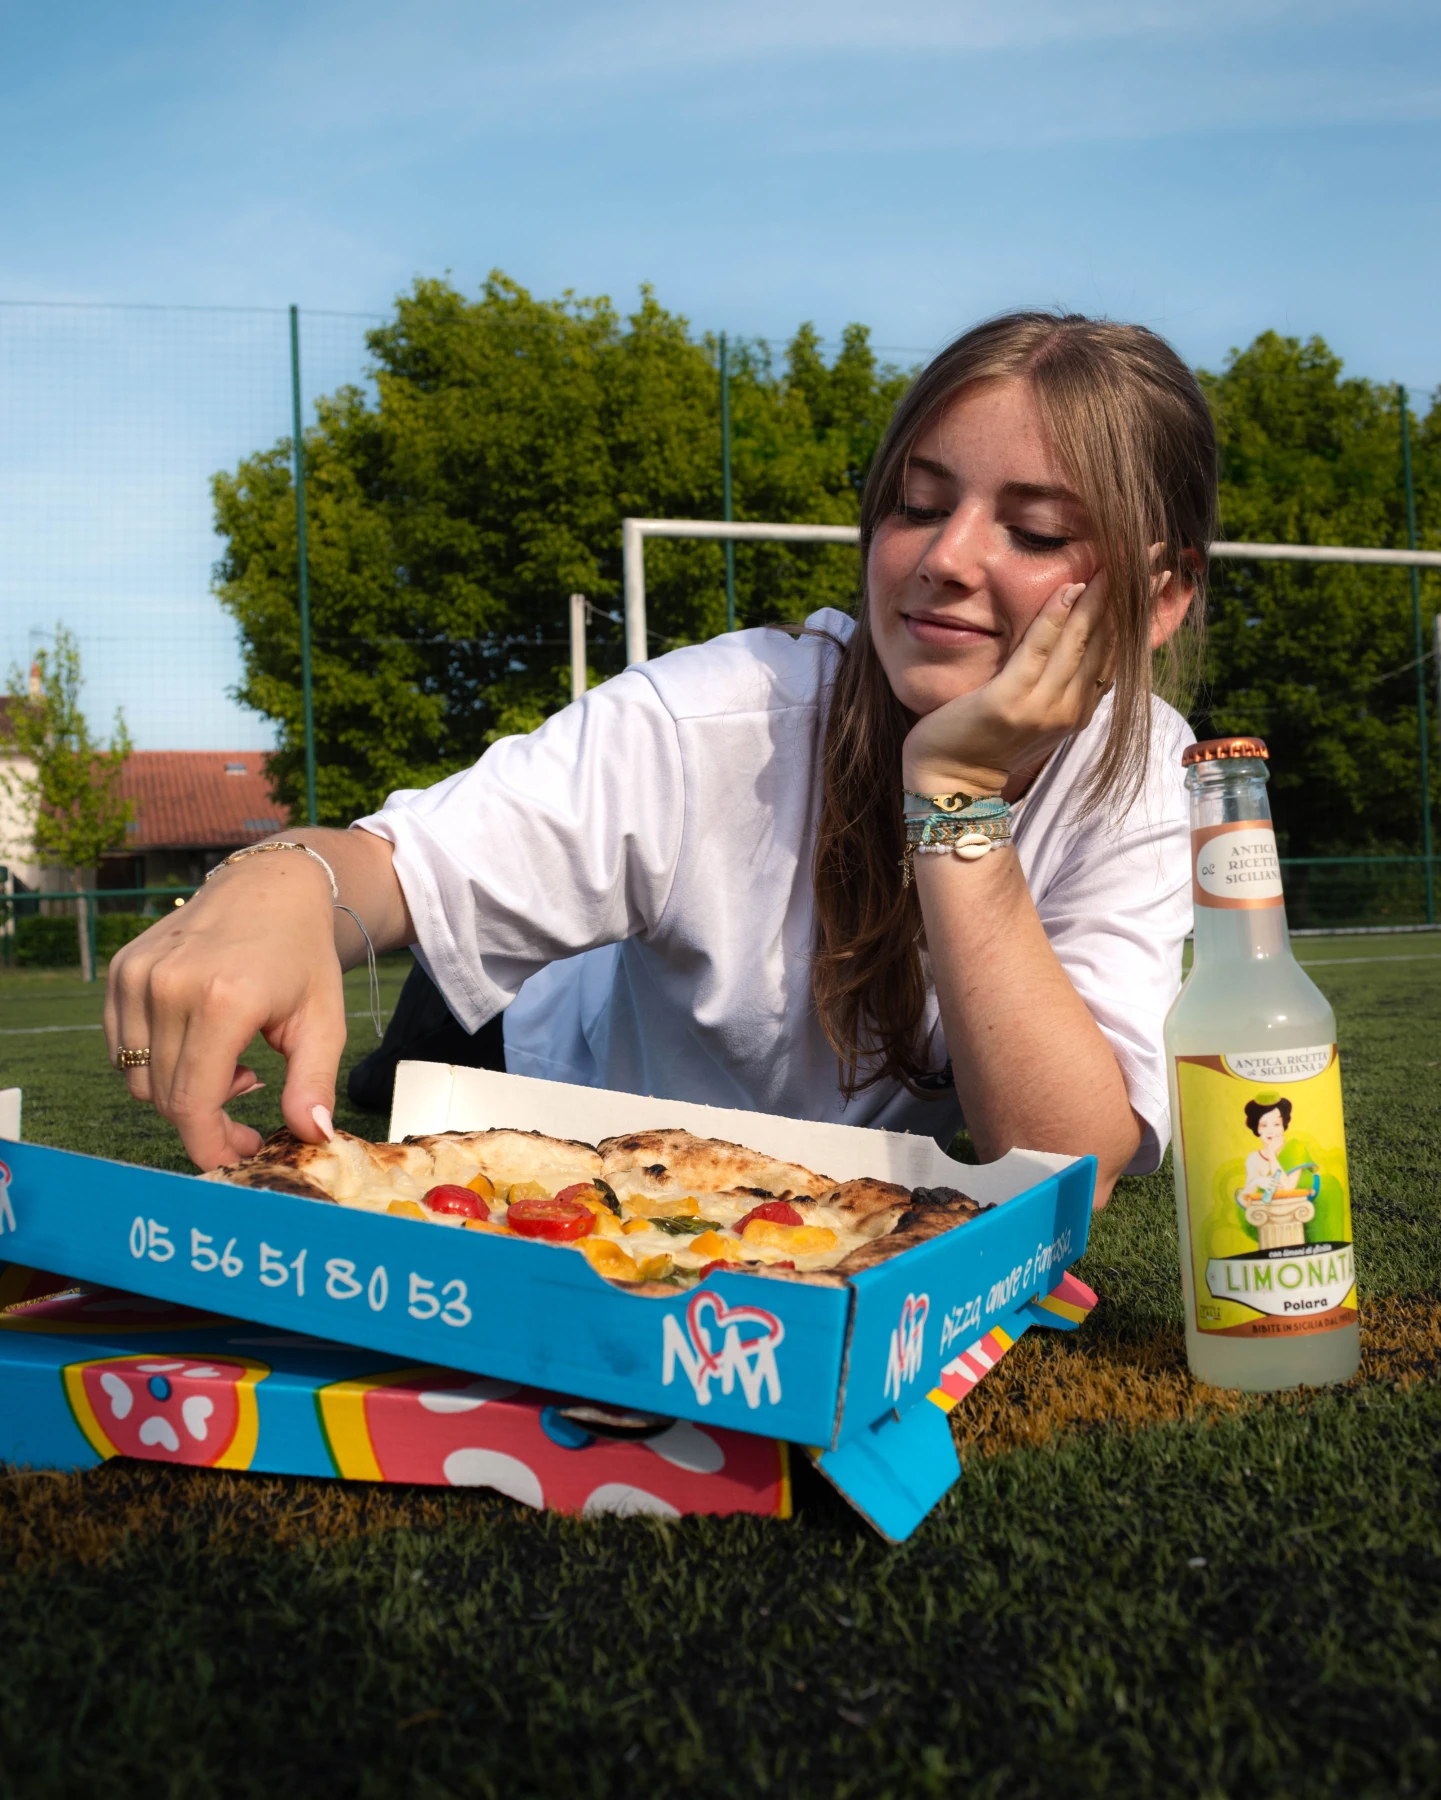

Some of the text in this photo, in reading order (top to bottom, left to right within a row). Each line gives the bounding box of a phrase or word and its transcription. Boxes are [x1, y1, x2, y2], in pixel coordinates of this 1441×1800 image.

[1225, 870, 1281, 884] SICILIAN
[1236, 1052, 1329, 1069] ANTICA RICETTA
[1260, 1063, 1316, 1076] SICILIANA
[129, 1216, 472, 1328] 05 56 51 80 53
[985, 1265, 1023, 1314] amore
[1022, 1258, 1033, 1289] e
[1283, 1297, 1328, 1312] Polara
[1252, 1323, 1281, 1334] BIBITE
[1282, 1322, 1293, 1332] IN
[1294, 1319, 1323, 1331] SICILIA
[1324, 1316, 1338, 1328] DAL
